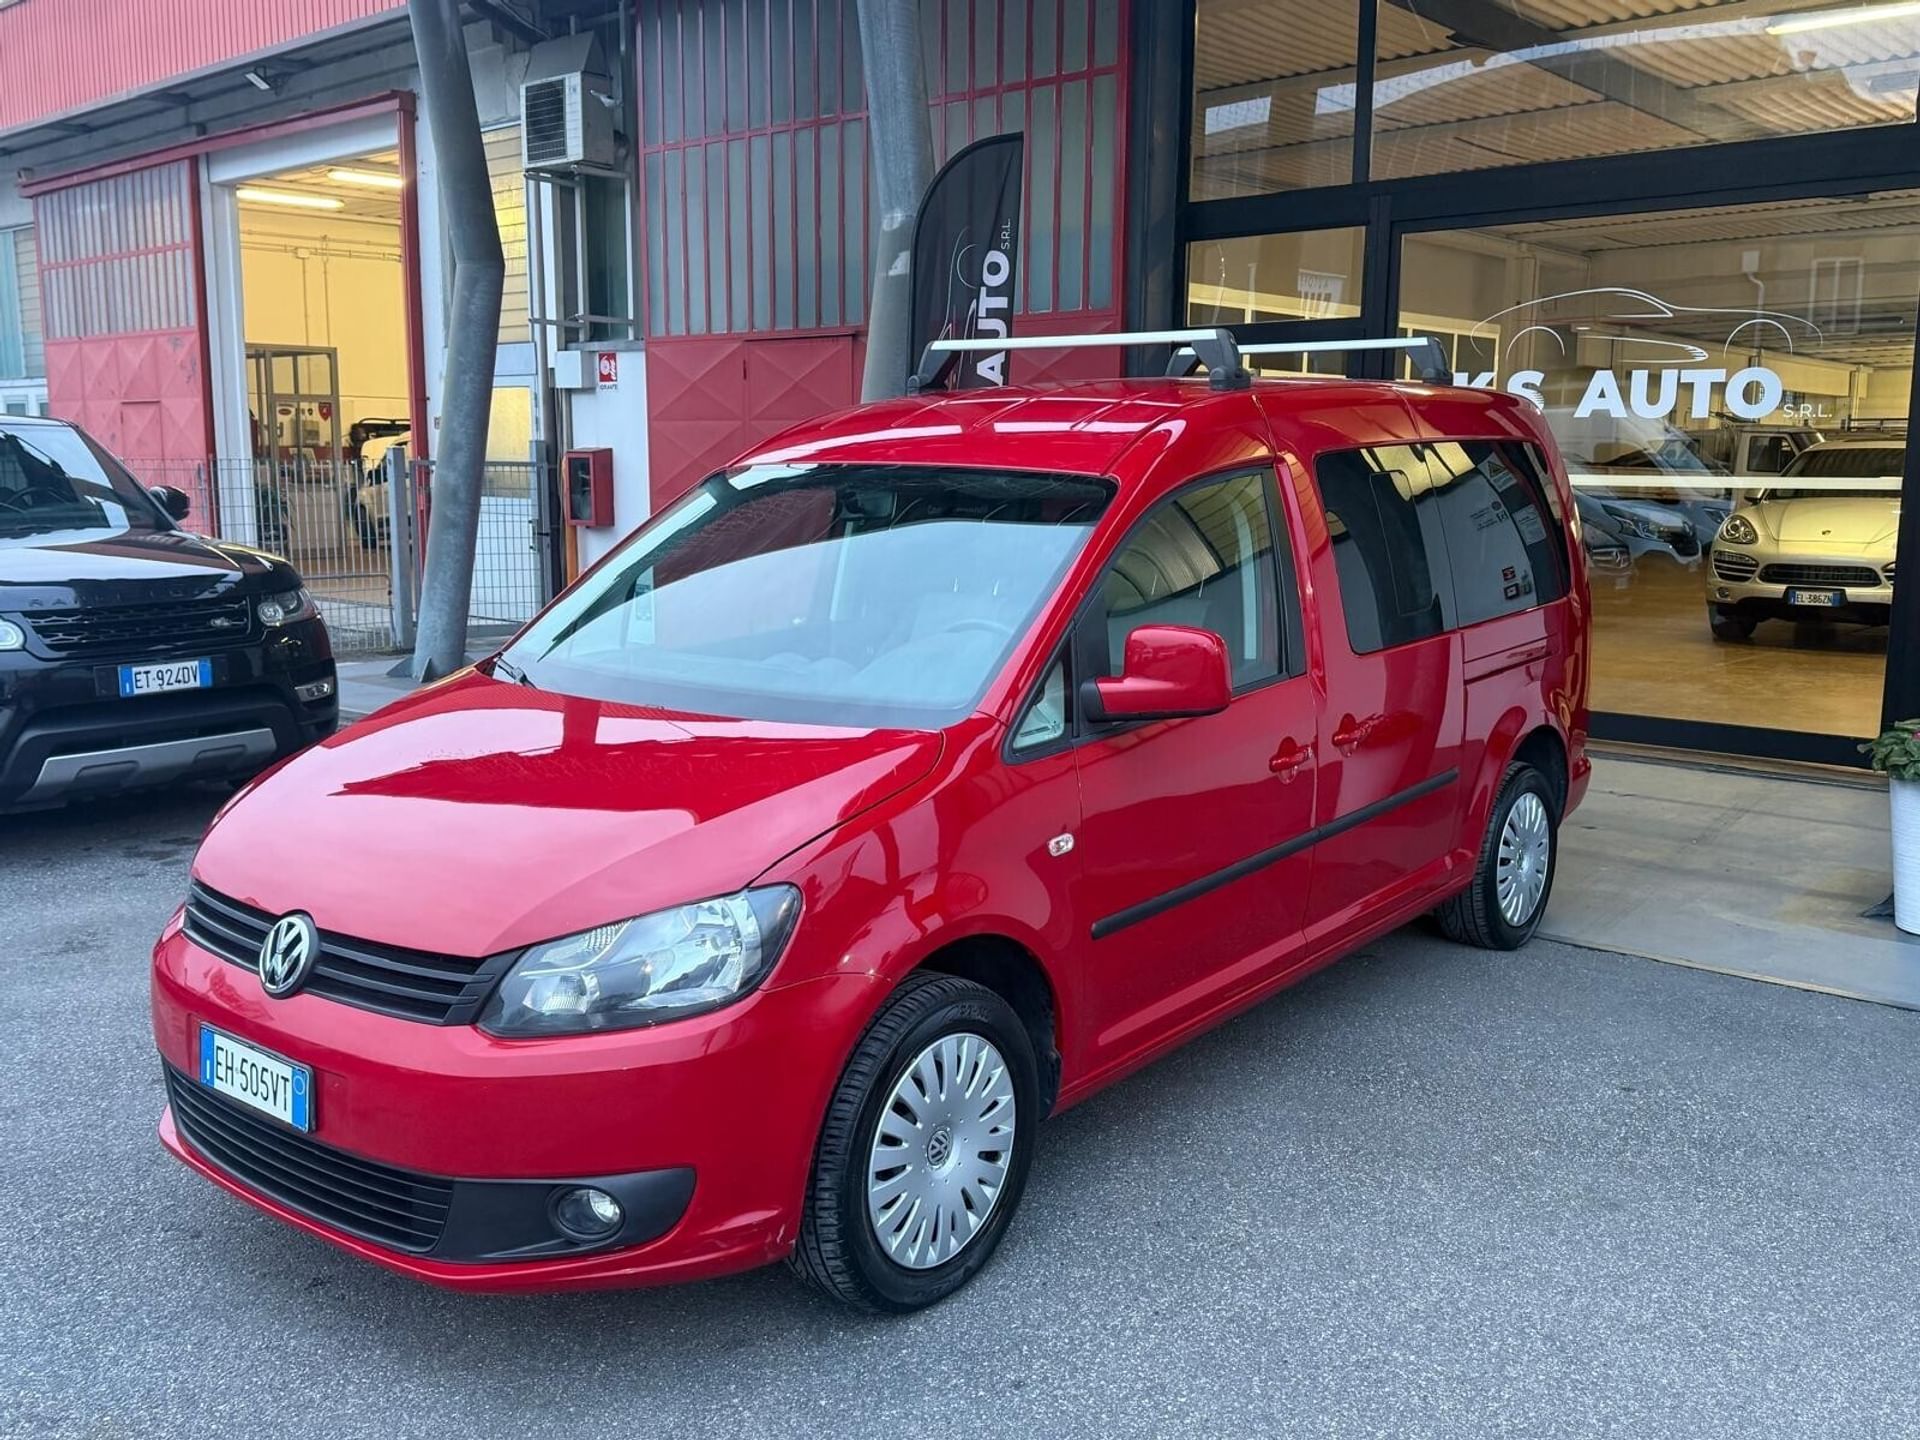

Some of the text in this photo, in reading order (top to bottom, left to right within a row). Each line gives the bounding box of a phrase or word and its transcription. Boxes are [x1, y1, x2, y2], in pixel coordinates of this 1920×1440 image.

[977, 250, 1010, 387] AUTO
[1573, 367, 1783, 419] AUTO
[1783, 403, 1833, 418] S.R.L.
